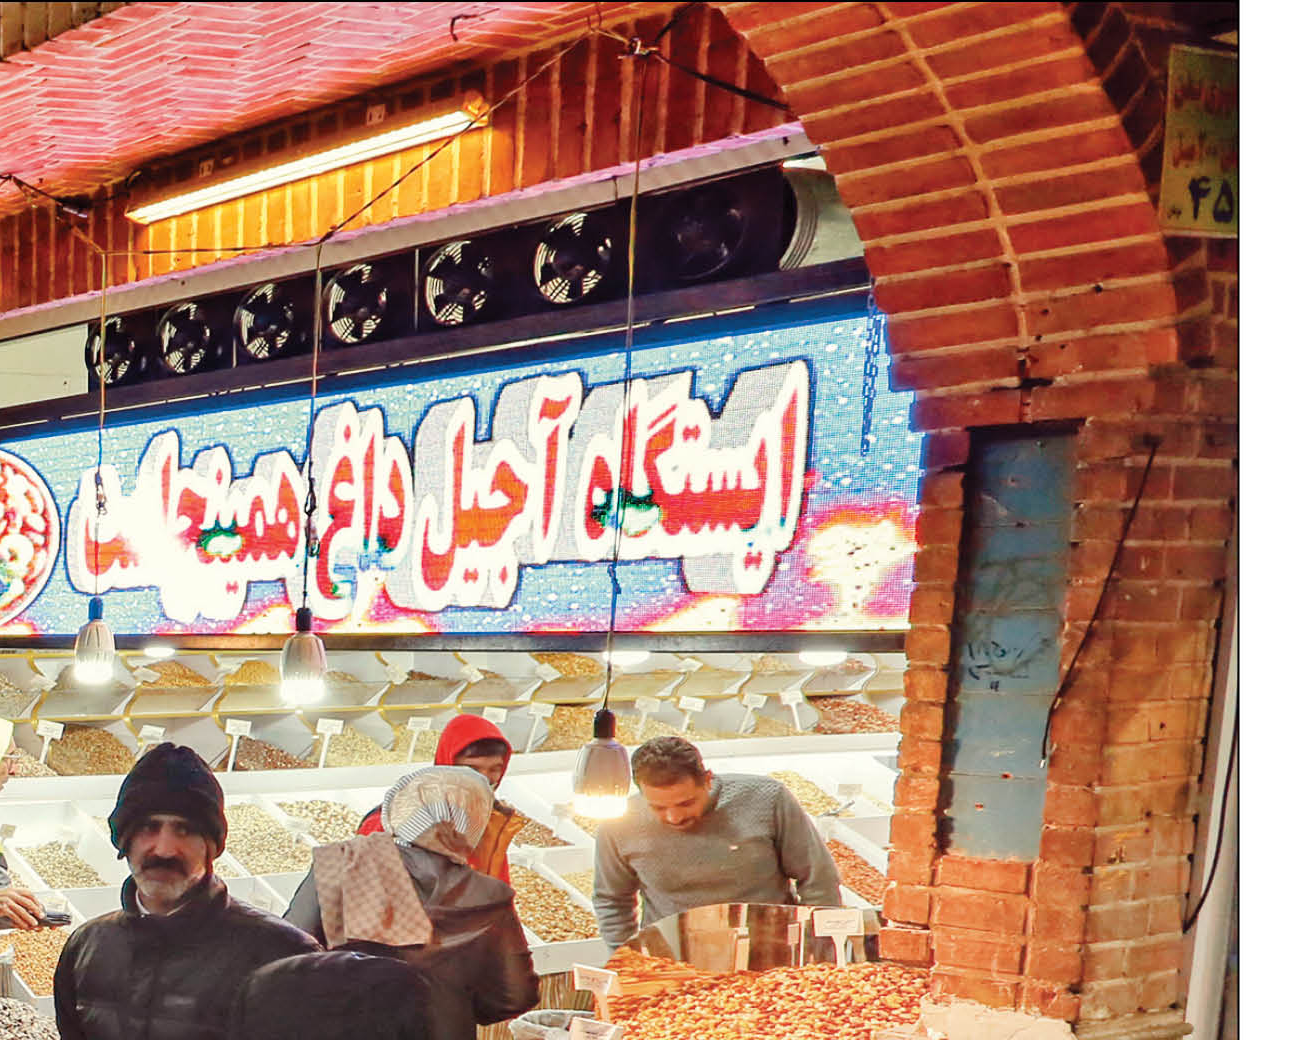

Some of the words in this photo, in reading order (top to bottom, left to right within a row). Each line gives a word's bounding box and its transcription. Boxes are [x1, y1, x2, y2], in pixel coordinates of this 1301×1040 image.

[313, 402, 413, 618] داغ
[413, 374, 581, 608] آجیل
[579, 362, 807, 592] ایستگاه
